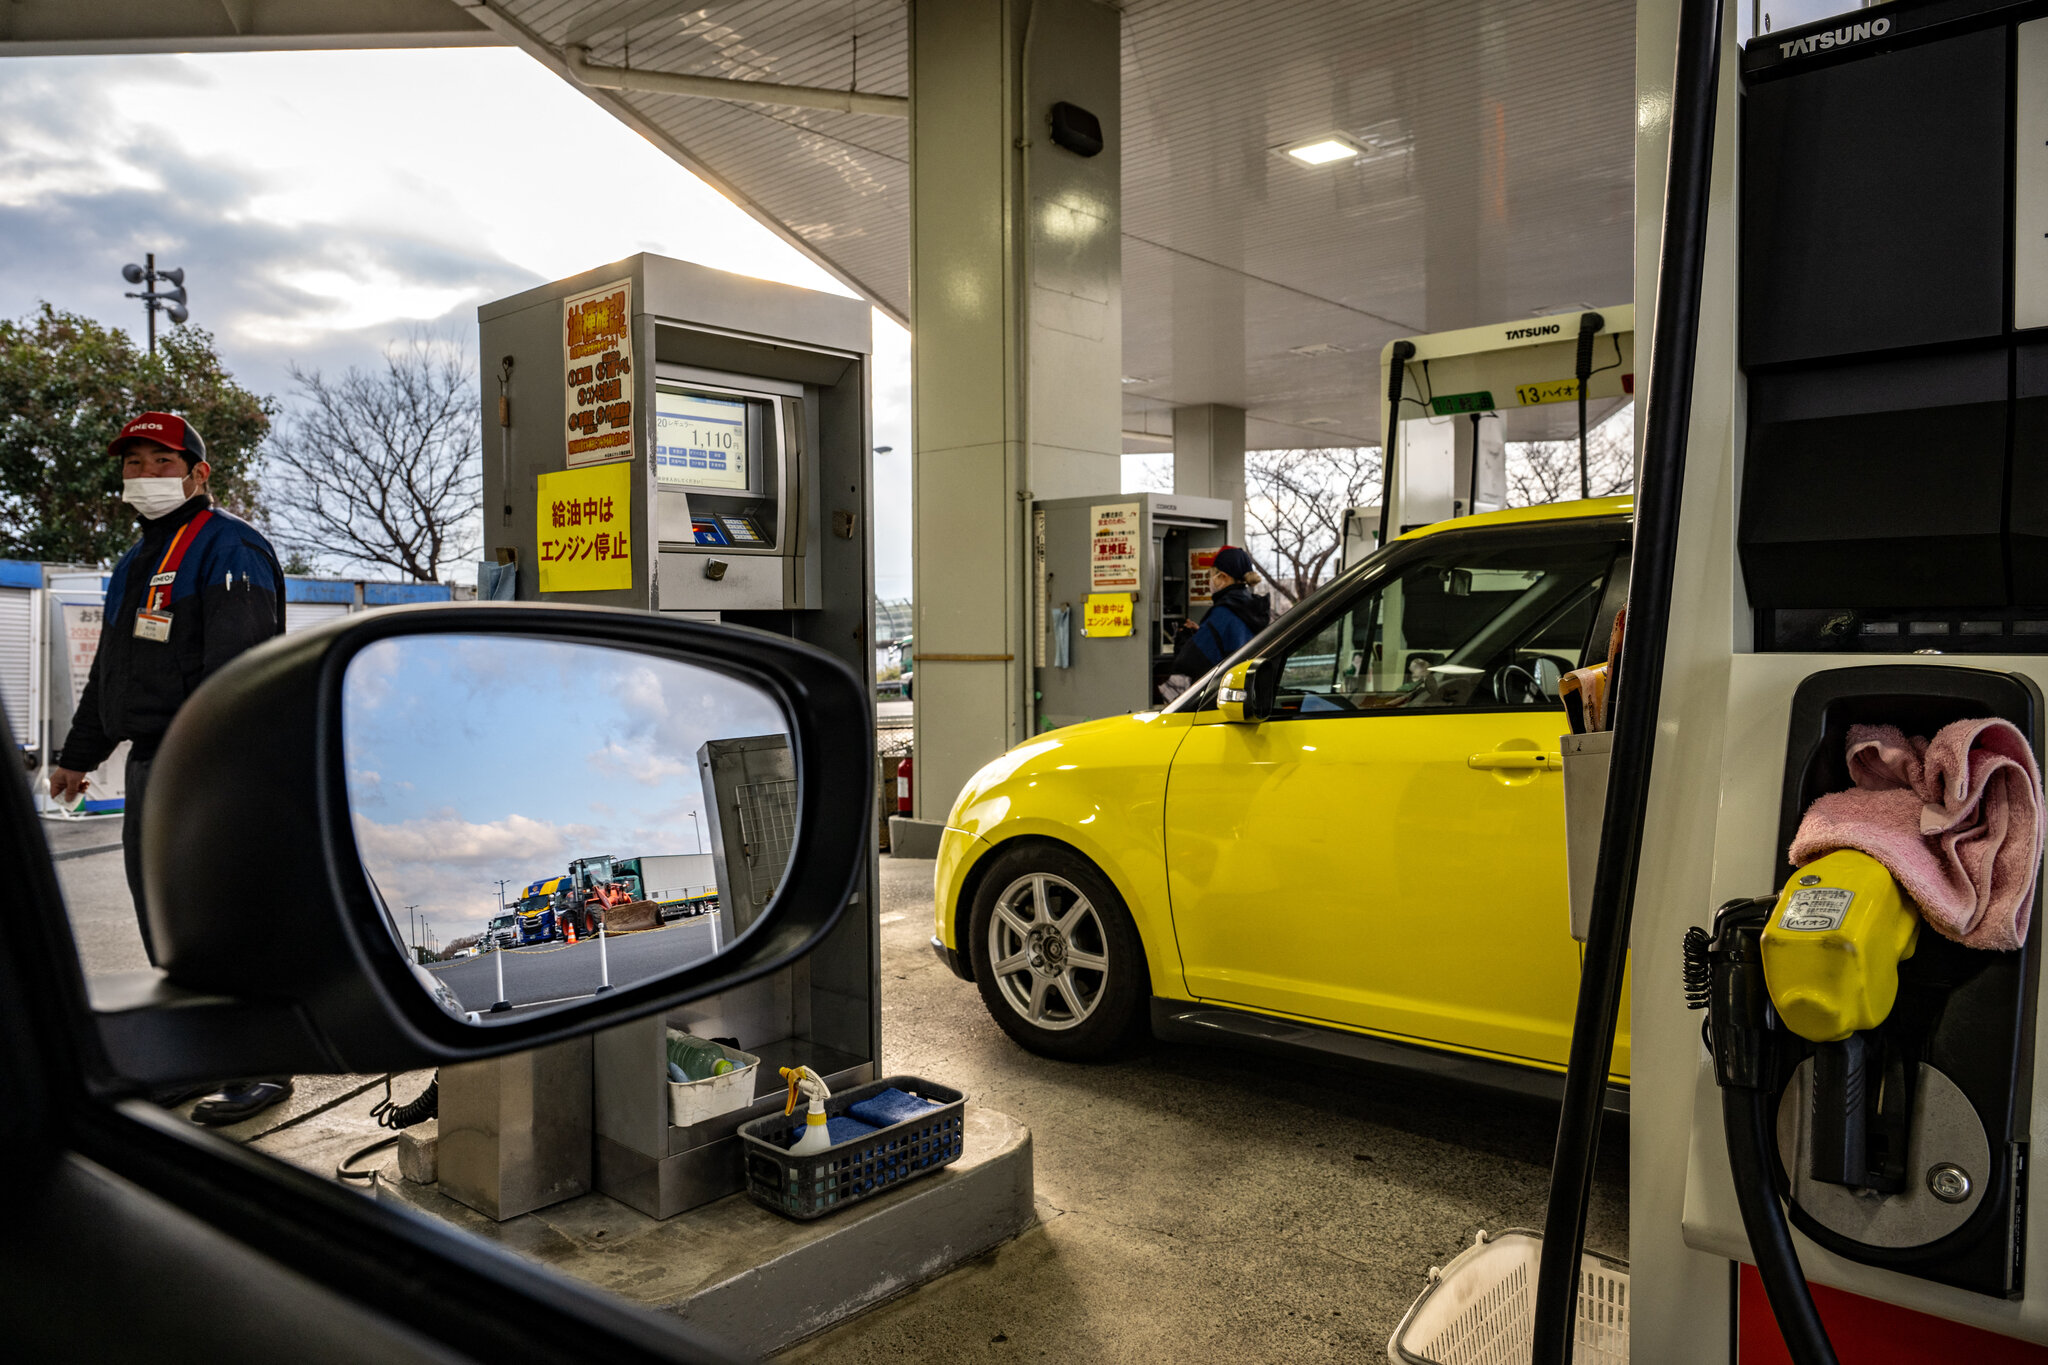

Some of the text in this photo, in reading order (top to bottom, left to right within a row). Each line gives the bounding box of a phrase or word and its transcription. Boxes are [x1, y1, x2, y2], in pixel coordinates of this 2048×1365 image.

[1779, 17, 1892, 59] TATSUNO
[1505, 324, 1560, 340] TATSUNO
[1517, 386, 1582, 405] 13 ハイオ
[129, 423, 163, 433] ENEOS
[692, 429, 732, 449] 1,110
[552, 496, 614, 528] 給油中は
[541, 531, 629, 562] エンジン停止
[1093, 604, 1124, 614] 給油中は
[1087, 616, 1131, 627] エンジン停止
